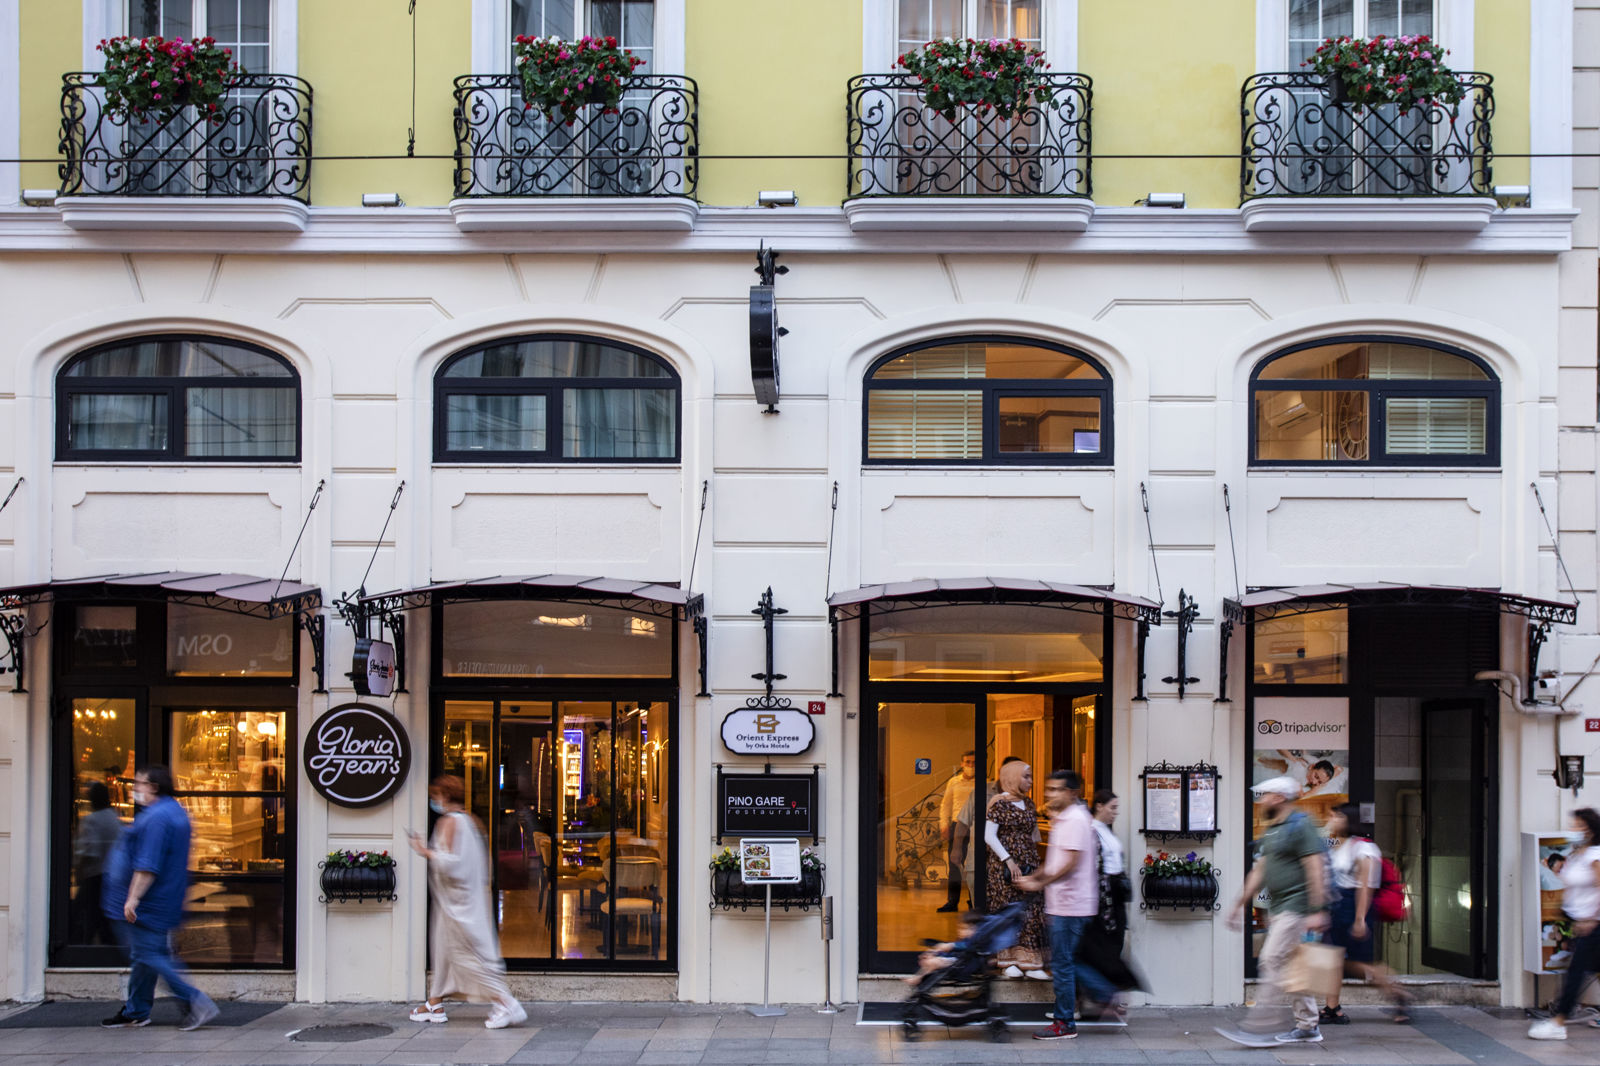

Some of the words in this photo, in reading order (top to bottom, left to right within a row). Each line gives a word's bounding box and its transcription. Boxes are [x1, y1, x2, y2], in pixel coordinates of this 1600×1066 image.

[1285, 722, 1343, 735] tripadvisor
[1589, 721, 1599, 729] 22
[312, 726, 395, 763] Gloria
[767, 734, 799, 744] Express
[319, 760, 400, 786] Jean's
[755, 796, 785, 806] GARE
